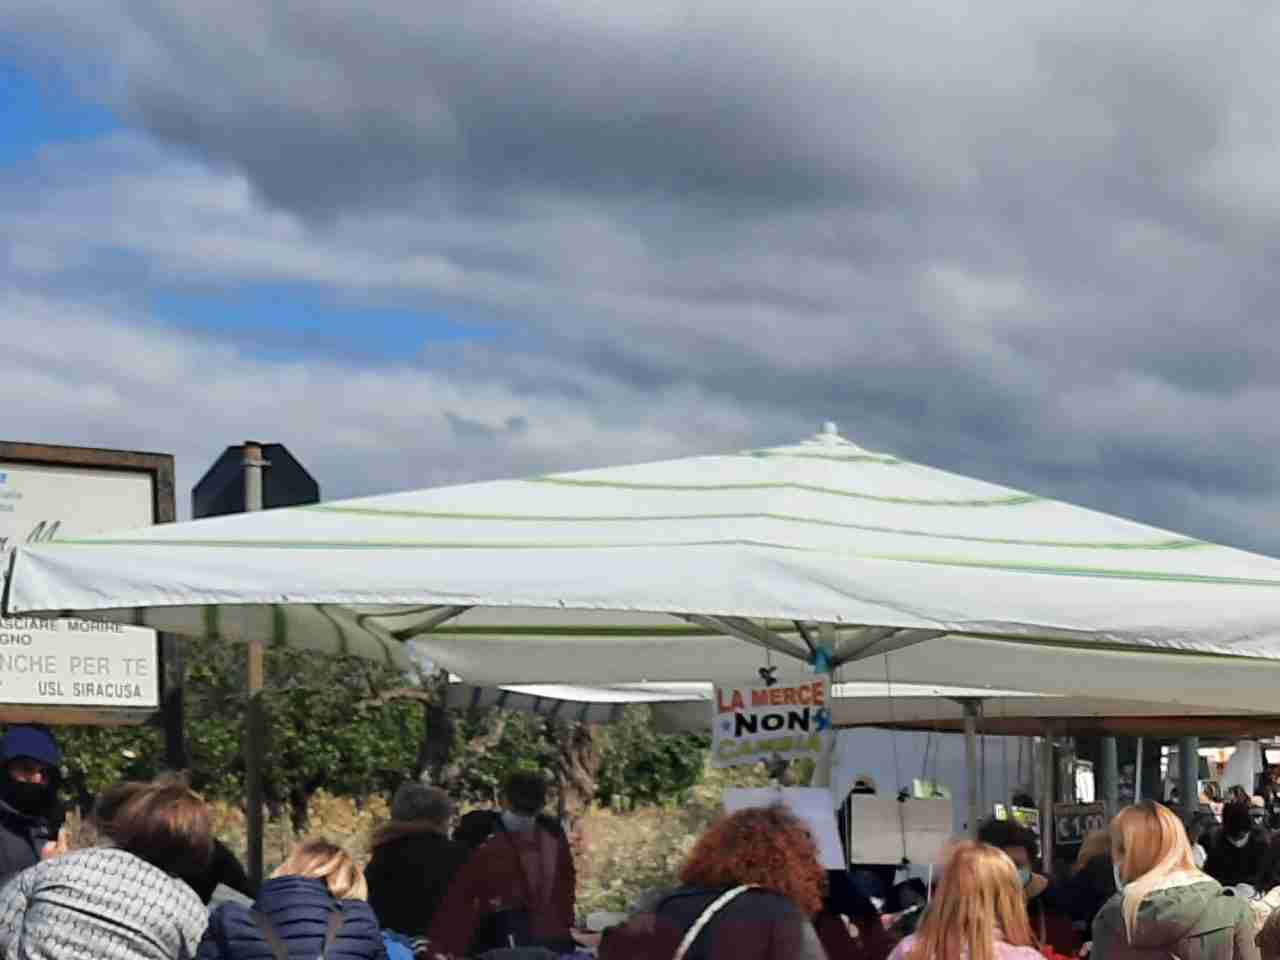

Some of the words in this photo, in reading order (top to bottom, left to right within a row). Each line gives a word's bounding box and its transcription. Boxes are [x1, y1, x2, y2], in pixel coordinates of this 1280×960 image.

[69, 655, 111, 675] PER
[121, 657, 149, 677] TE
[38, 680, 65, 696] USL
[72, 681, 142, 698] SIRACUSA
[717, 687, 745, 713] LA
[751, 681, 824, 705] MERCE
[735, 707, 810, 737] NON
